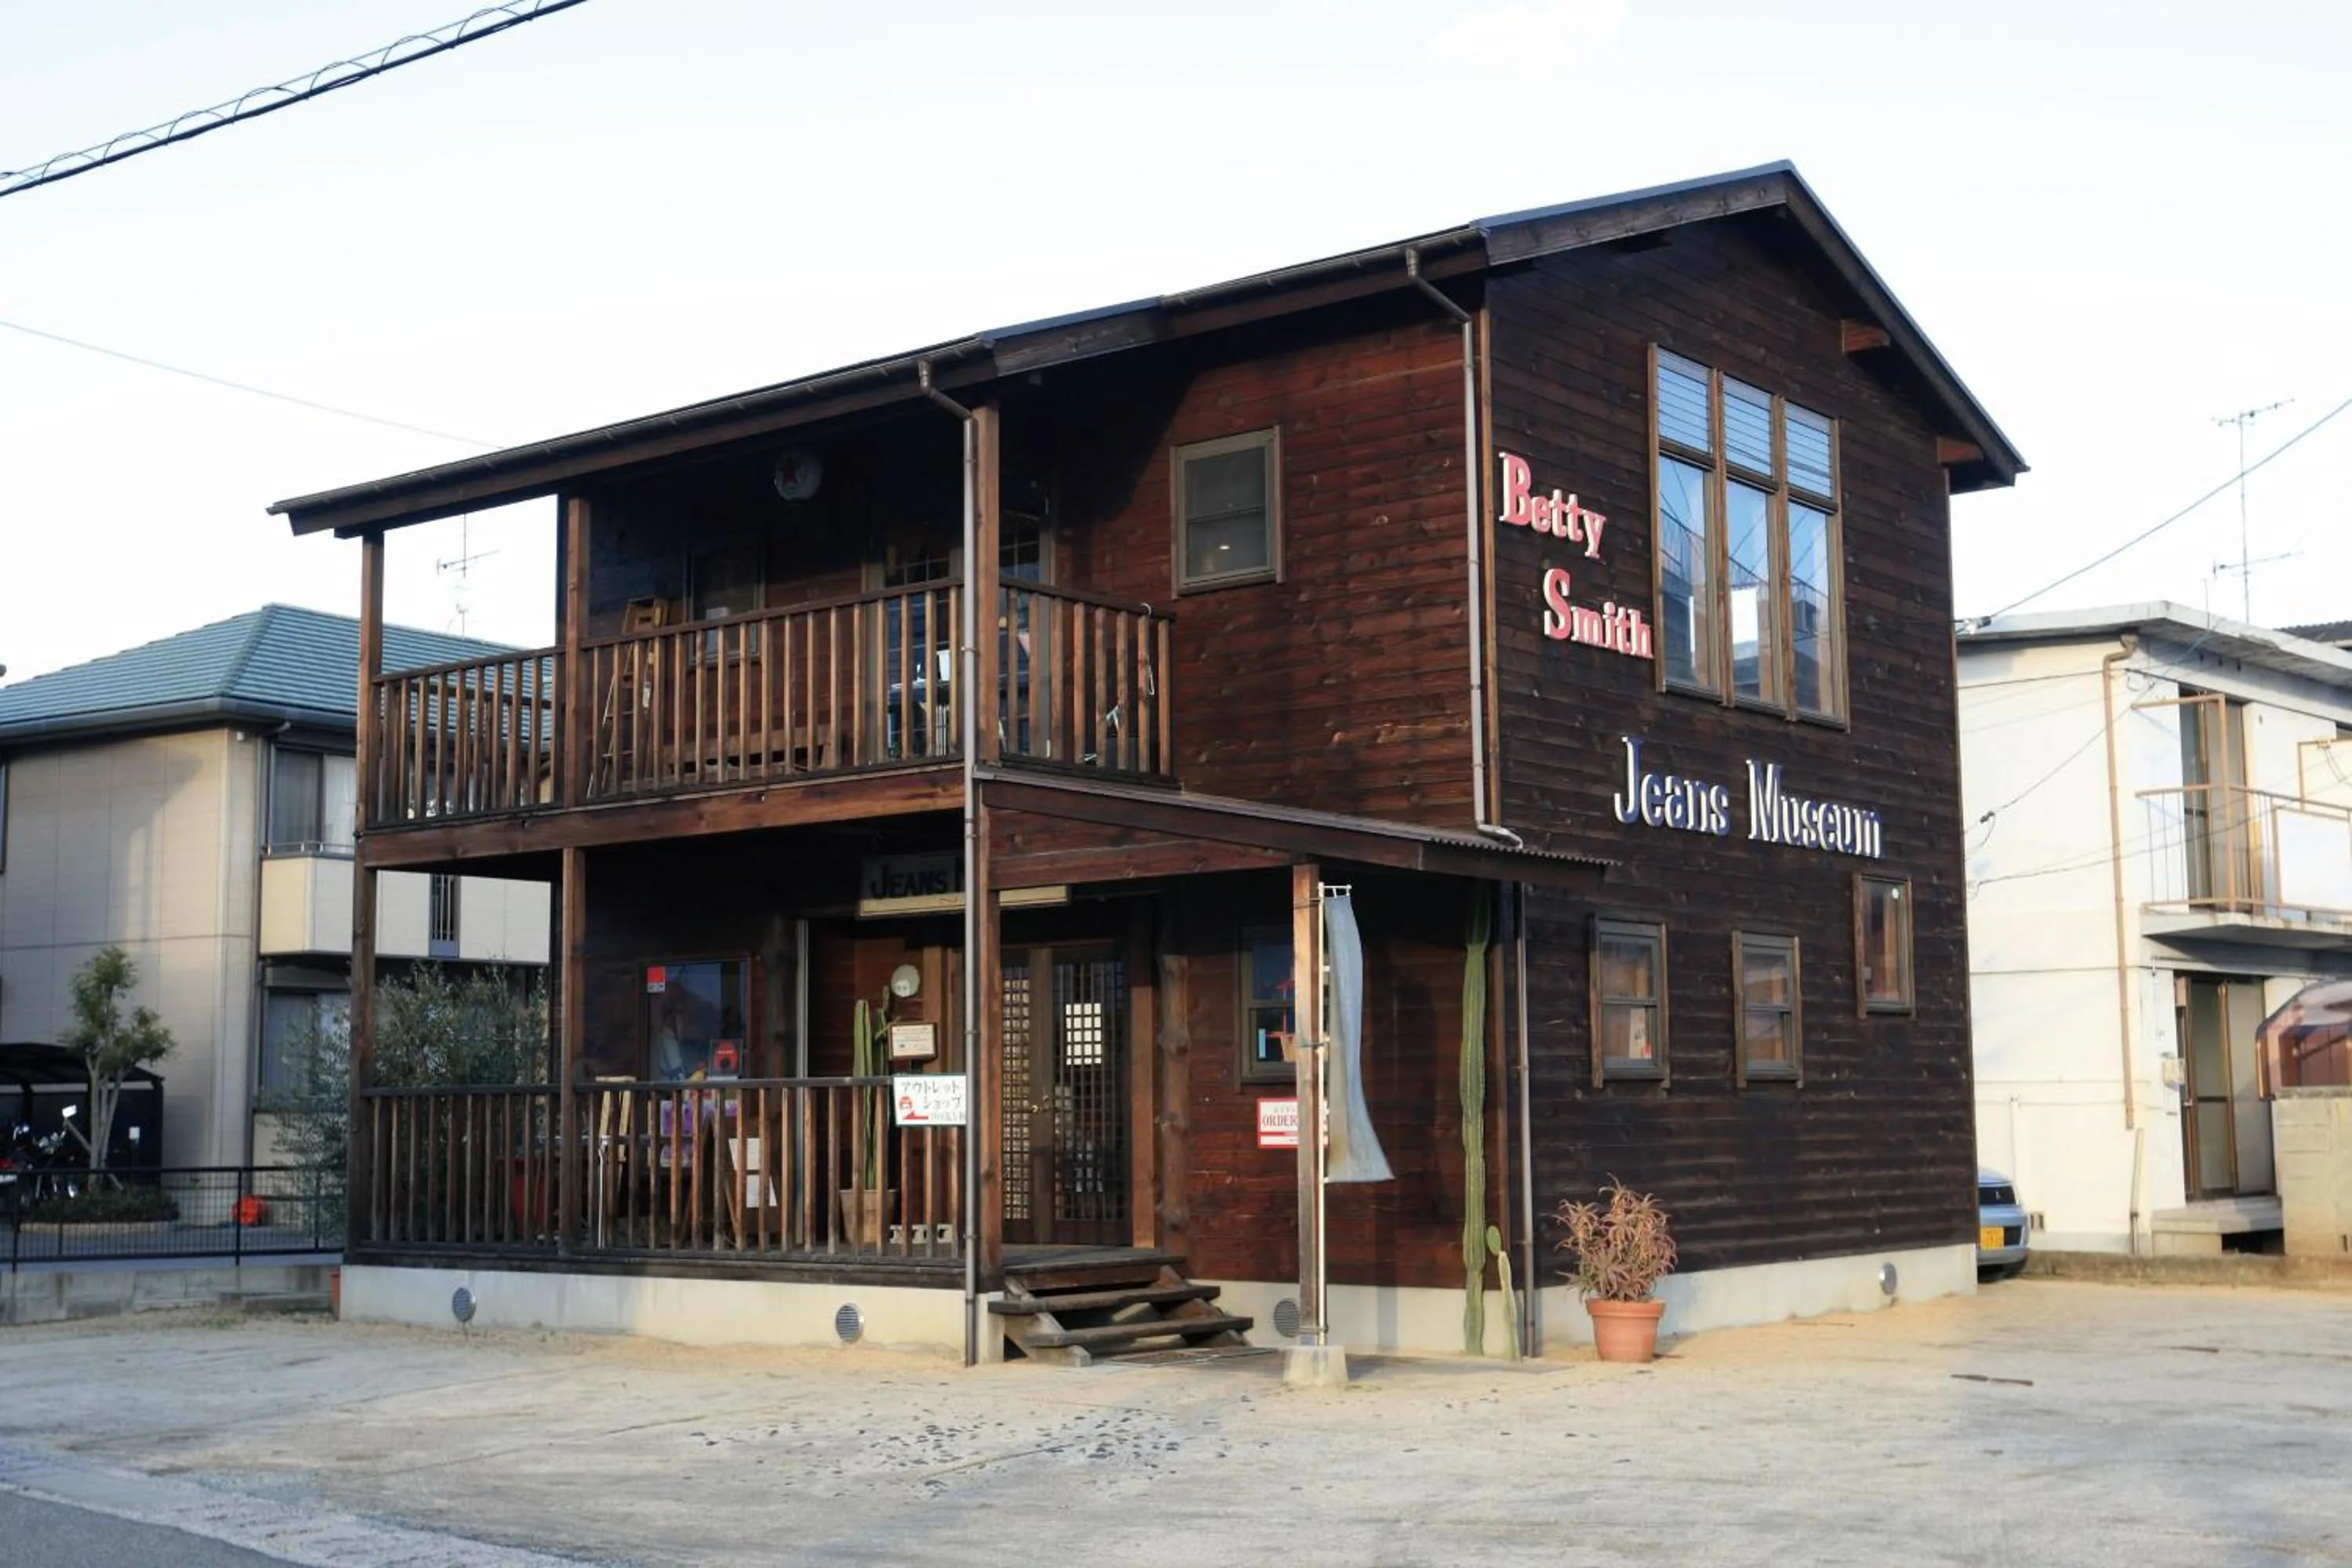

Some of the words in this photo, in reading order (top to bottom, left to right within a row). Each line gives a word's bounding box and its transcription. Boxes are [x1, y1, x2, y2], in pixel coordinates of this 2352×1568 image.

[1499, 452, 1606, 558] Betty
[1543, 568, 1653, 658] Smith
[1614, 736, 1730, 835] Jeans
[1747, 759, 1882, 858] Museum
